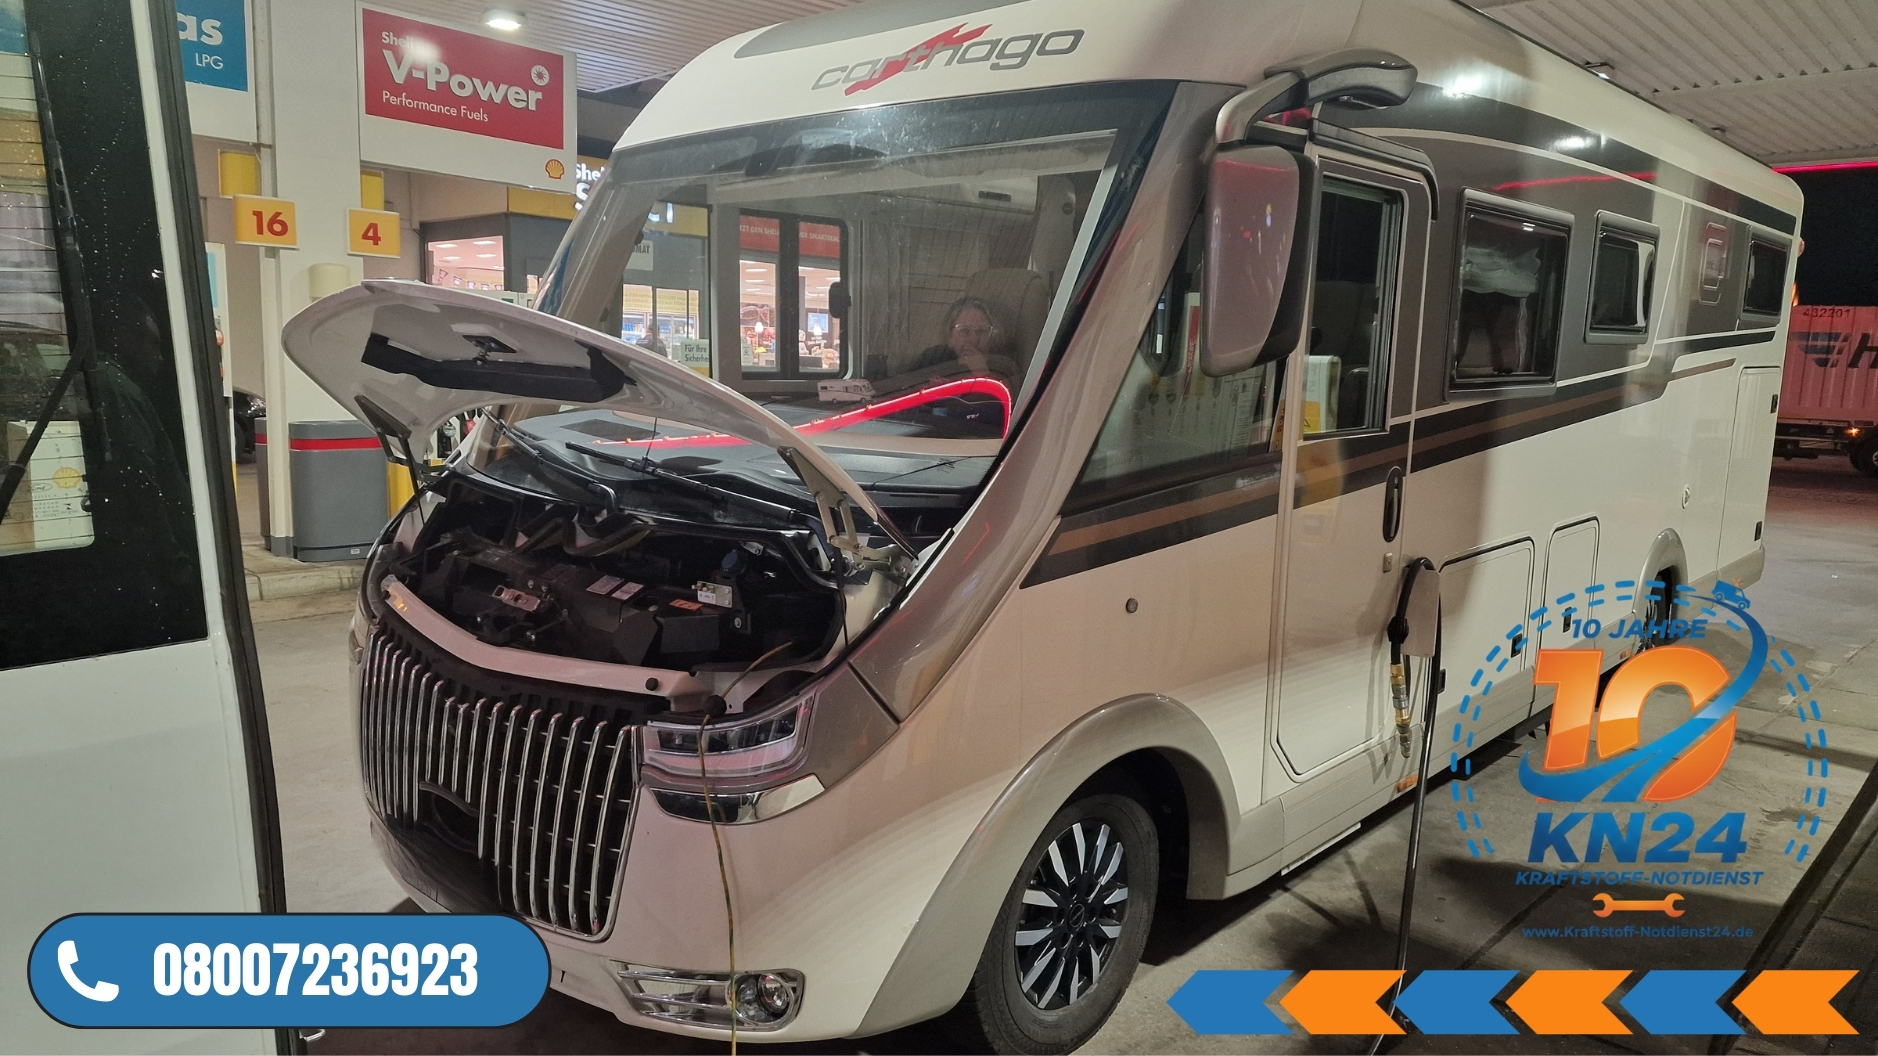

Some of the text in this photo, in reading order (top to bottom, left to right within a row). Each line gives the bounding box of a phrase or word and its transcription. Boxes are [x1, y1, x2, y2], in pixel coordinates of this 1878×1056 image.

[195, 52, 224, 70] LPG
[811, 29, 1085, 91] carthago
[381, 48, 543, 111] V-Power
[382, 90, 489, 122] Performance Fuels
[252, 210, 289, 237] 16
[361, 222, 382, 246] 4
[684, 344, 707, 353] Für Ihre
[684, 353, 710, 362] Sicherhe
